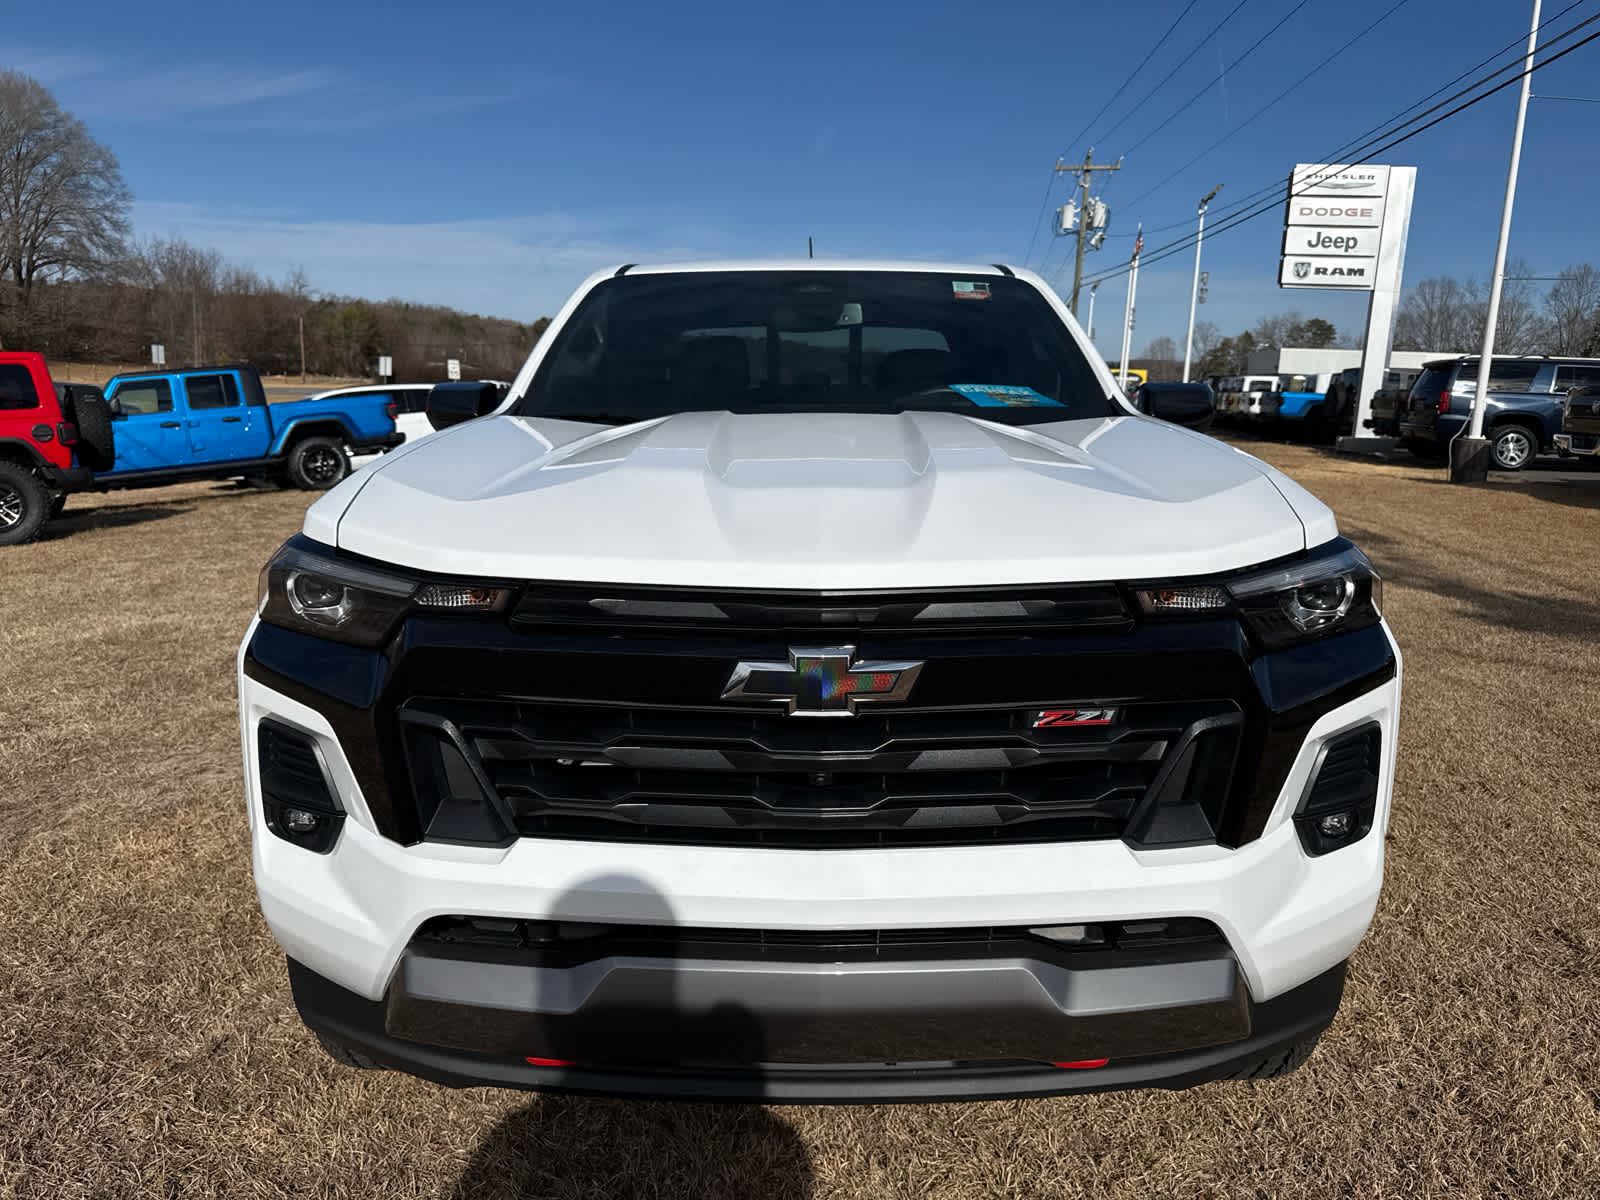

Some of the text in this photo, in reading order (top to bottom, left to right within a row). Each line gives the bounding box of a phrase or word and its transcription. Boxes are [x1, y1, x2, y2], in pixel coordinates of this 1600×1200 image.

[1300, 207, 1373, 217] DODGE
[1307, 231, 1358, 252] Jeep
[1314, 267, 1365, 277] RAM
